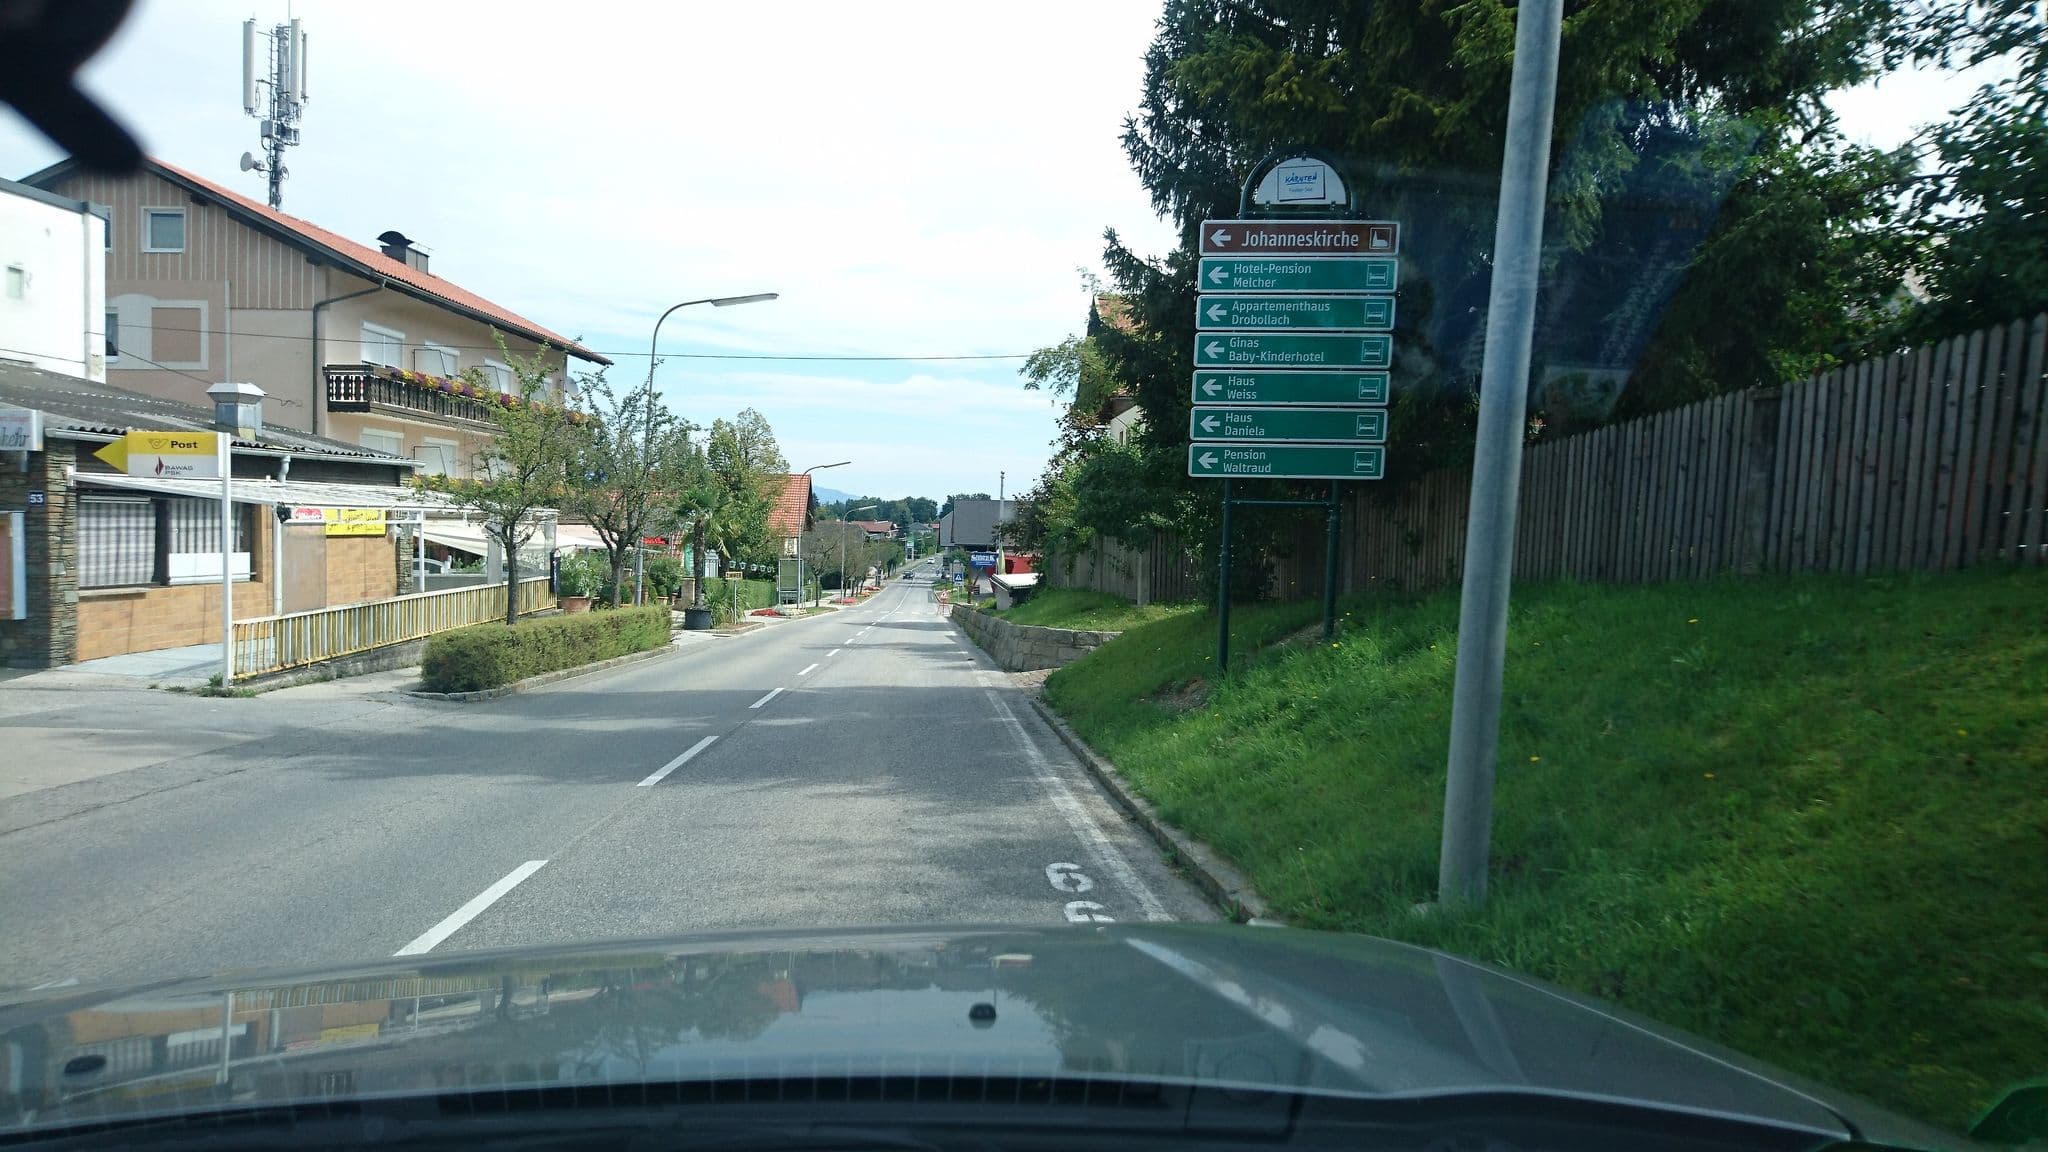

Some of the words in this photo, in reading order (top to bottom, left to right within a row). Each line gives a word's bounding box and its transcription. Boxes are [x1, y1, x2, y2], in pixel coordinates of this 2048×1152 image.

[1242, 229, 1359, 247] Johanneskirche
[1234, 263, 1311, 274] Hotel-Pension
[1233, 277, 1276, 288] Melcher
[1232, 301, 1330, 314] Appartementhaus
[1231, 314, 1290, 325] Drobollach
[1229, 337, 1259, 348] Ginas
[1229, 351, 1324, 363] Baby-Kinderhotel
[1228, 376, 1255, 387] Haus
[1227, 389, 1257, 400] Weiss
[1225, 413, 1252, 423] Haus
[1224, 426, 1265, 436] Daniela
[170, 440, 198, 449] Post
[1224, 449, 1266, 460] Pension
[1223, 462, 1272, 473] Waltraud
[30, 494, 44, 503] 53
